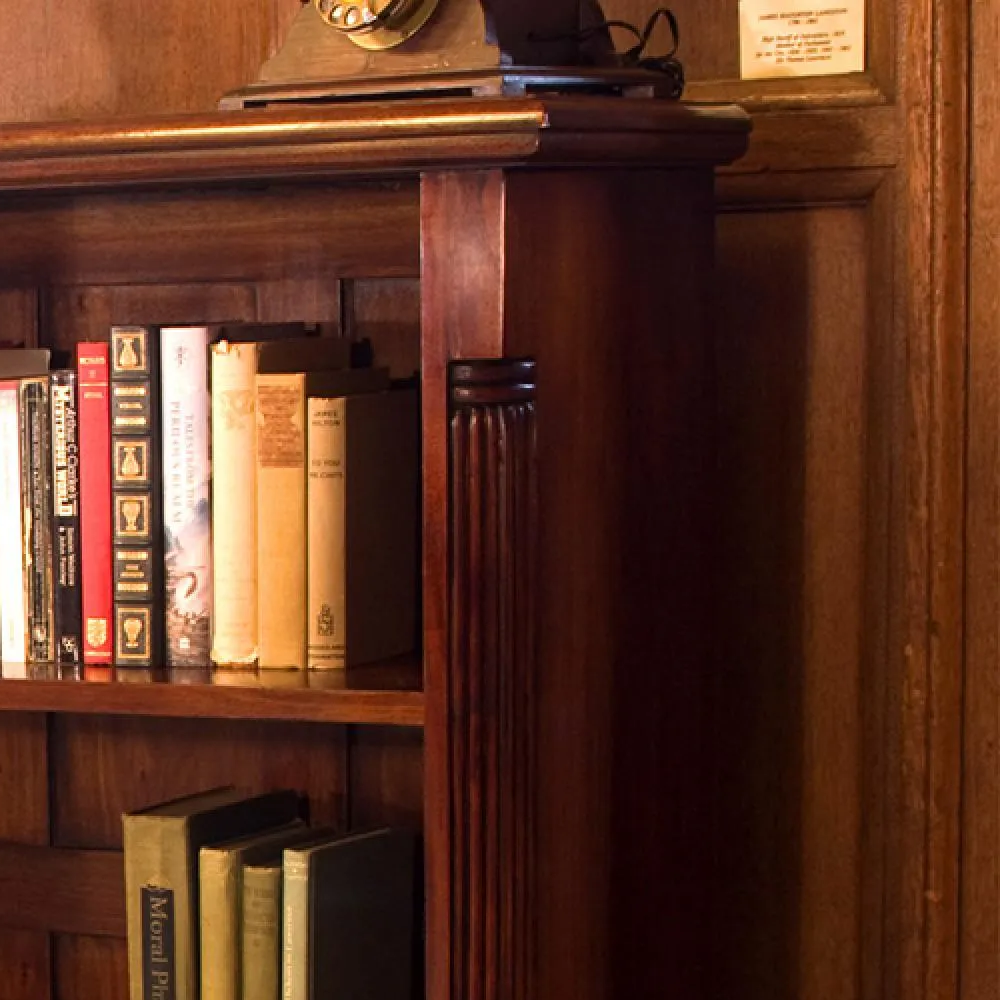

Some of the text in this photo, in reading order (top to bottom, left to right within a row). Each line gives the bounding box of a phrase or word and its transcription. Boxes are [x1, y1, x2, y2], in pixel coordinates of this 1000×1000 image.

[66, 408, 75, 442] Arthur
[185, 414, 195, 449] TALES
[52, 385, 72, 517] MYSTERIOUS WORLD
[170, 401, 184, 523] PERILOUS REALM
[186, 451, 195, 484] FROM
[150, 895, 168, 963] Moral
